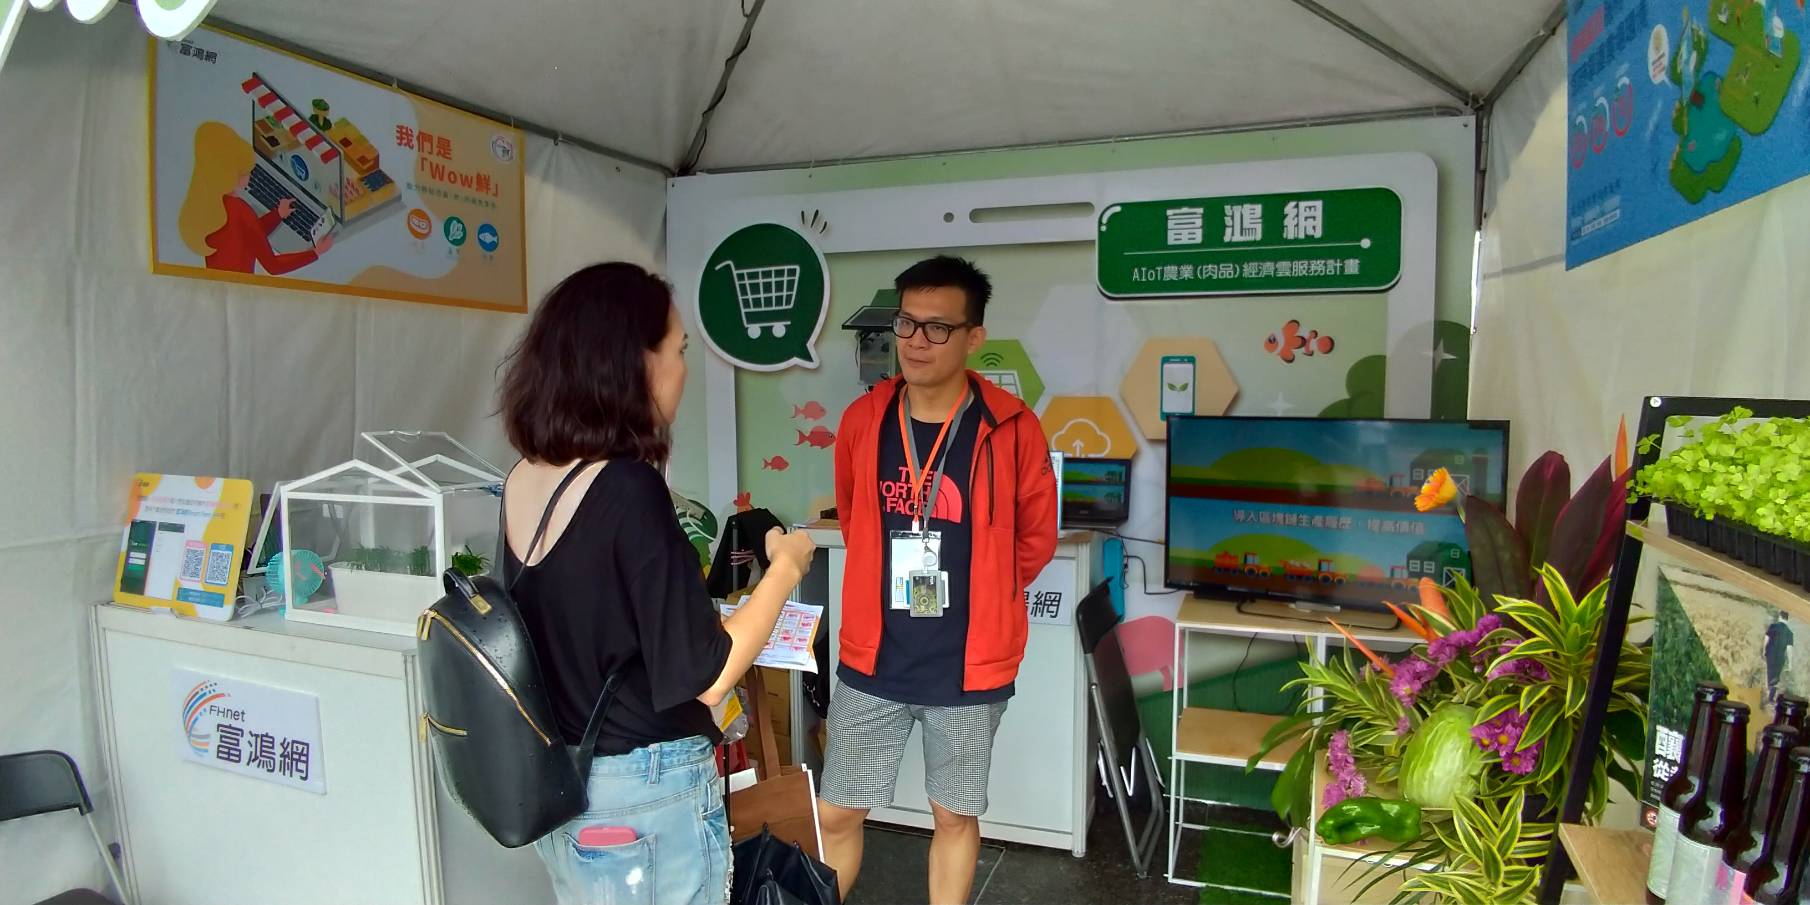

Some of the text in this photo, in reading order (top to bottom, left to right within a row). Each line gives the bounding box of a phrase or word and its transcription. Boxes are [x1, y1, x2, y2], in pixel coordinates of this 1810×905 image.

[396, 125, 452, 160] 我們是
[1166, 200, 1323, 246] 富鴻網
[899, 466, 934, 486] TE
[209, 704, 247, 723] FHnet
[216, 723, 311, 782] 富鴻網
